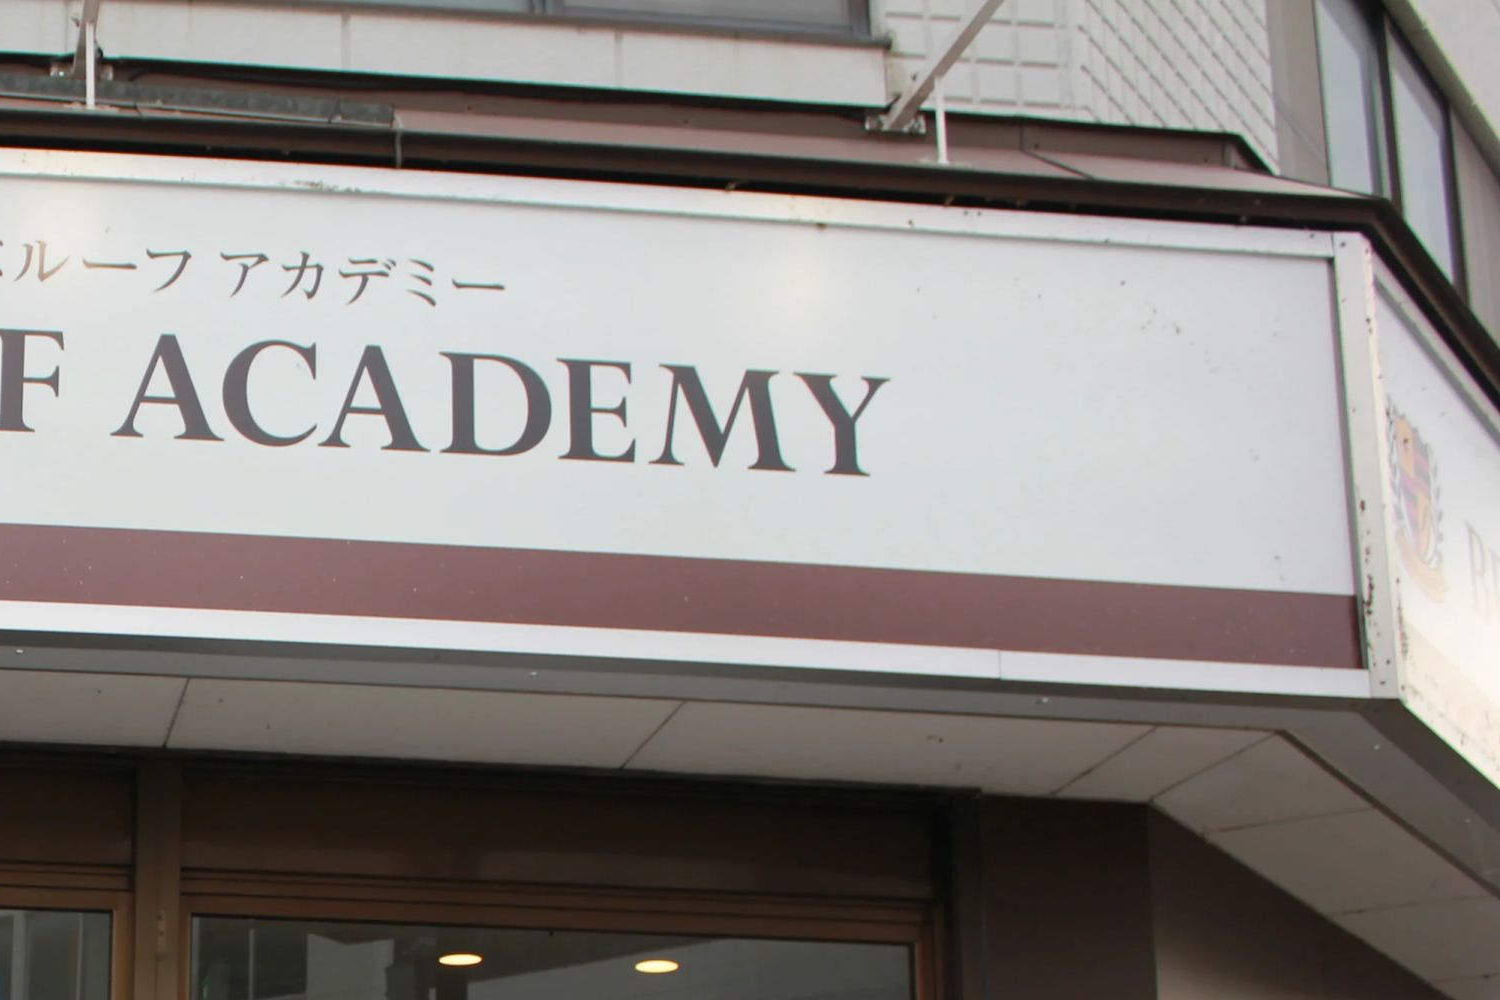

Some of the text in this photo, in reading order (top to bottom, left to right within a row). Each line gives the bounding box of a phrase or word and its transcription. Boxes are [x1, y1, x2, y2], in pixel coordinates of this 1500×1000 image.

[219, 249, 506, 307] アカデミー
[109, 333, 892, 477] ACADEMY
